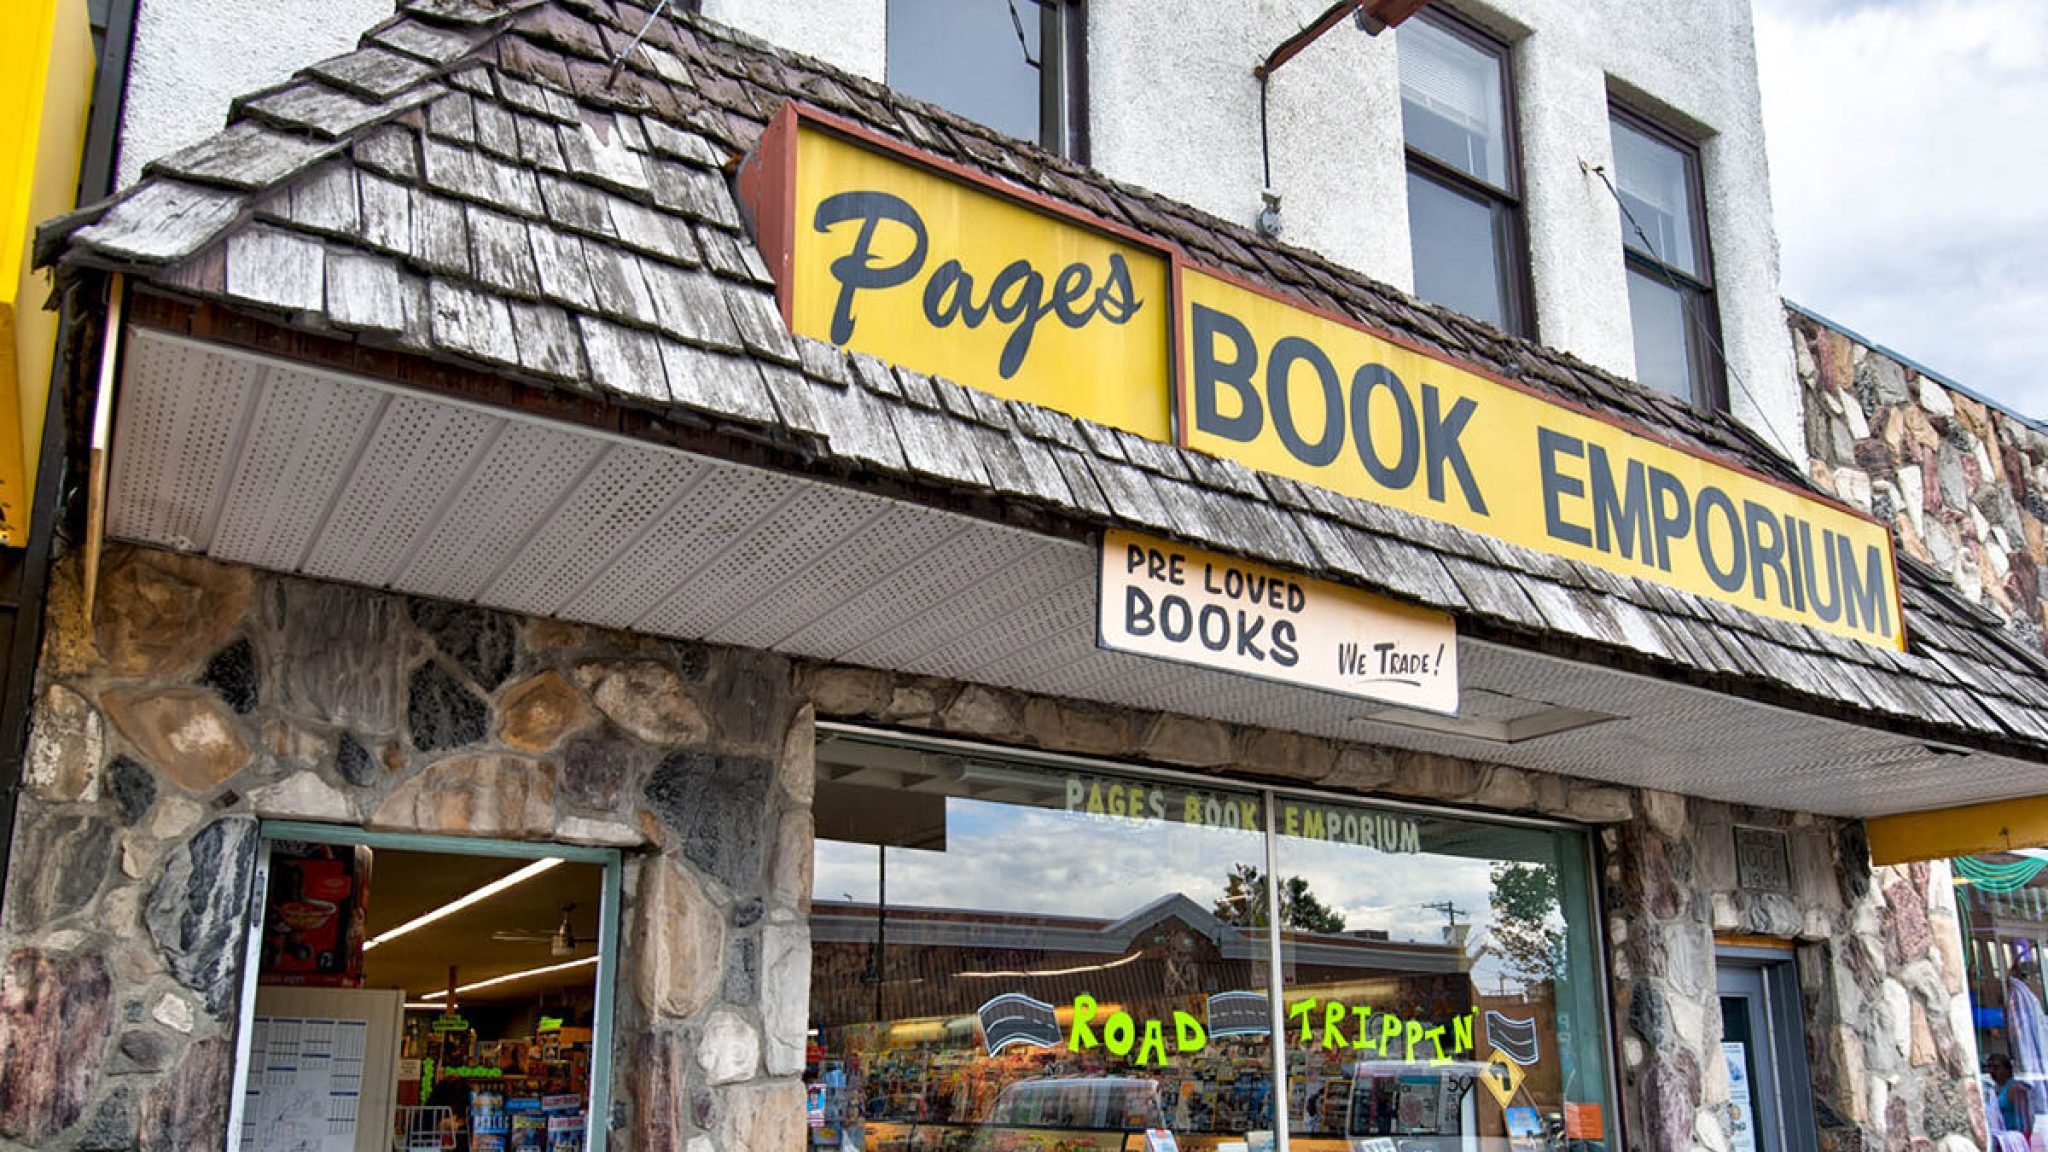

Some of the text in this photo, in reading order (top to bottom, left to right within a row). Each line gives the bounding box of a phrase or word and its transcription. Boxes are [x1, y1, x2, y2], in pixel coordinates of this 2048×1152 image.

[813, 190, 1144, 379] Pages
[1191, 302, 1892, 638] BOOK EMPORIUM
[1126, 543, 1306, 614] PRE LOVED
[1125, 585, 1300, 667] BOOKS
[1065, 779, 1421, 854] PAGES BOOK EMPORIUM
[1068, 993, 1480, 1067] ROAD TRIPPIN'
